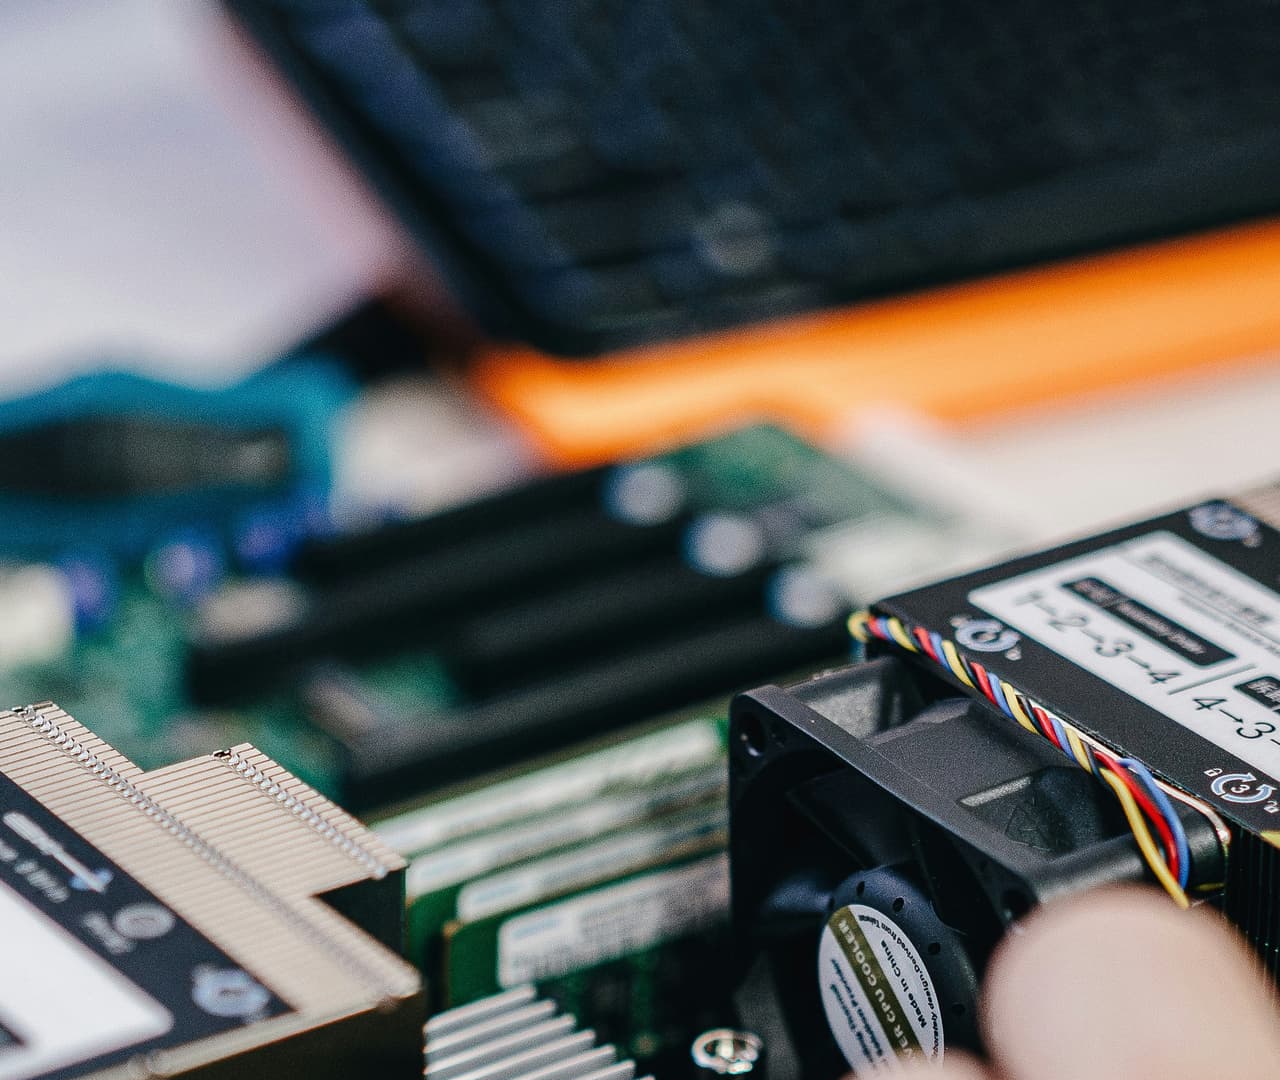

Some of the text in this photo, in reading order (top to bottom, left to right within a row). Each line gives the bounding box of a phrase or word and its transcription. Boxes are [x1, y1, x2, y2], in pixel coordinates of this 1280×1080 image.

[1047, 615, 1088, 632] 2
[1093, 640, 1134, 658] 3
[1148, 671, 1182, 685] 4
[1192, 698, 1228, 711] 4
[1236, 721, 1276, 740] 3
[1230, 784, 1251, 794] 3
[837, 919, 878, 987] COOLER
[880, 939, 902, 978] China
[874, 988, 896, 1024] CPU
[908, 992, 928, 1029] Made
